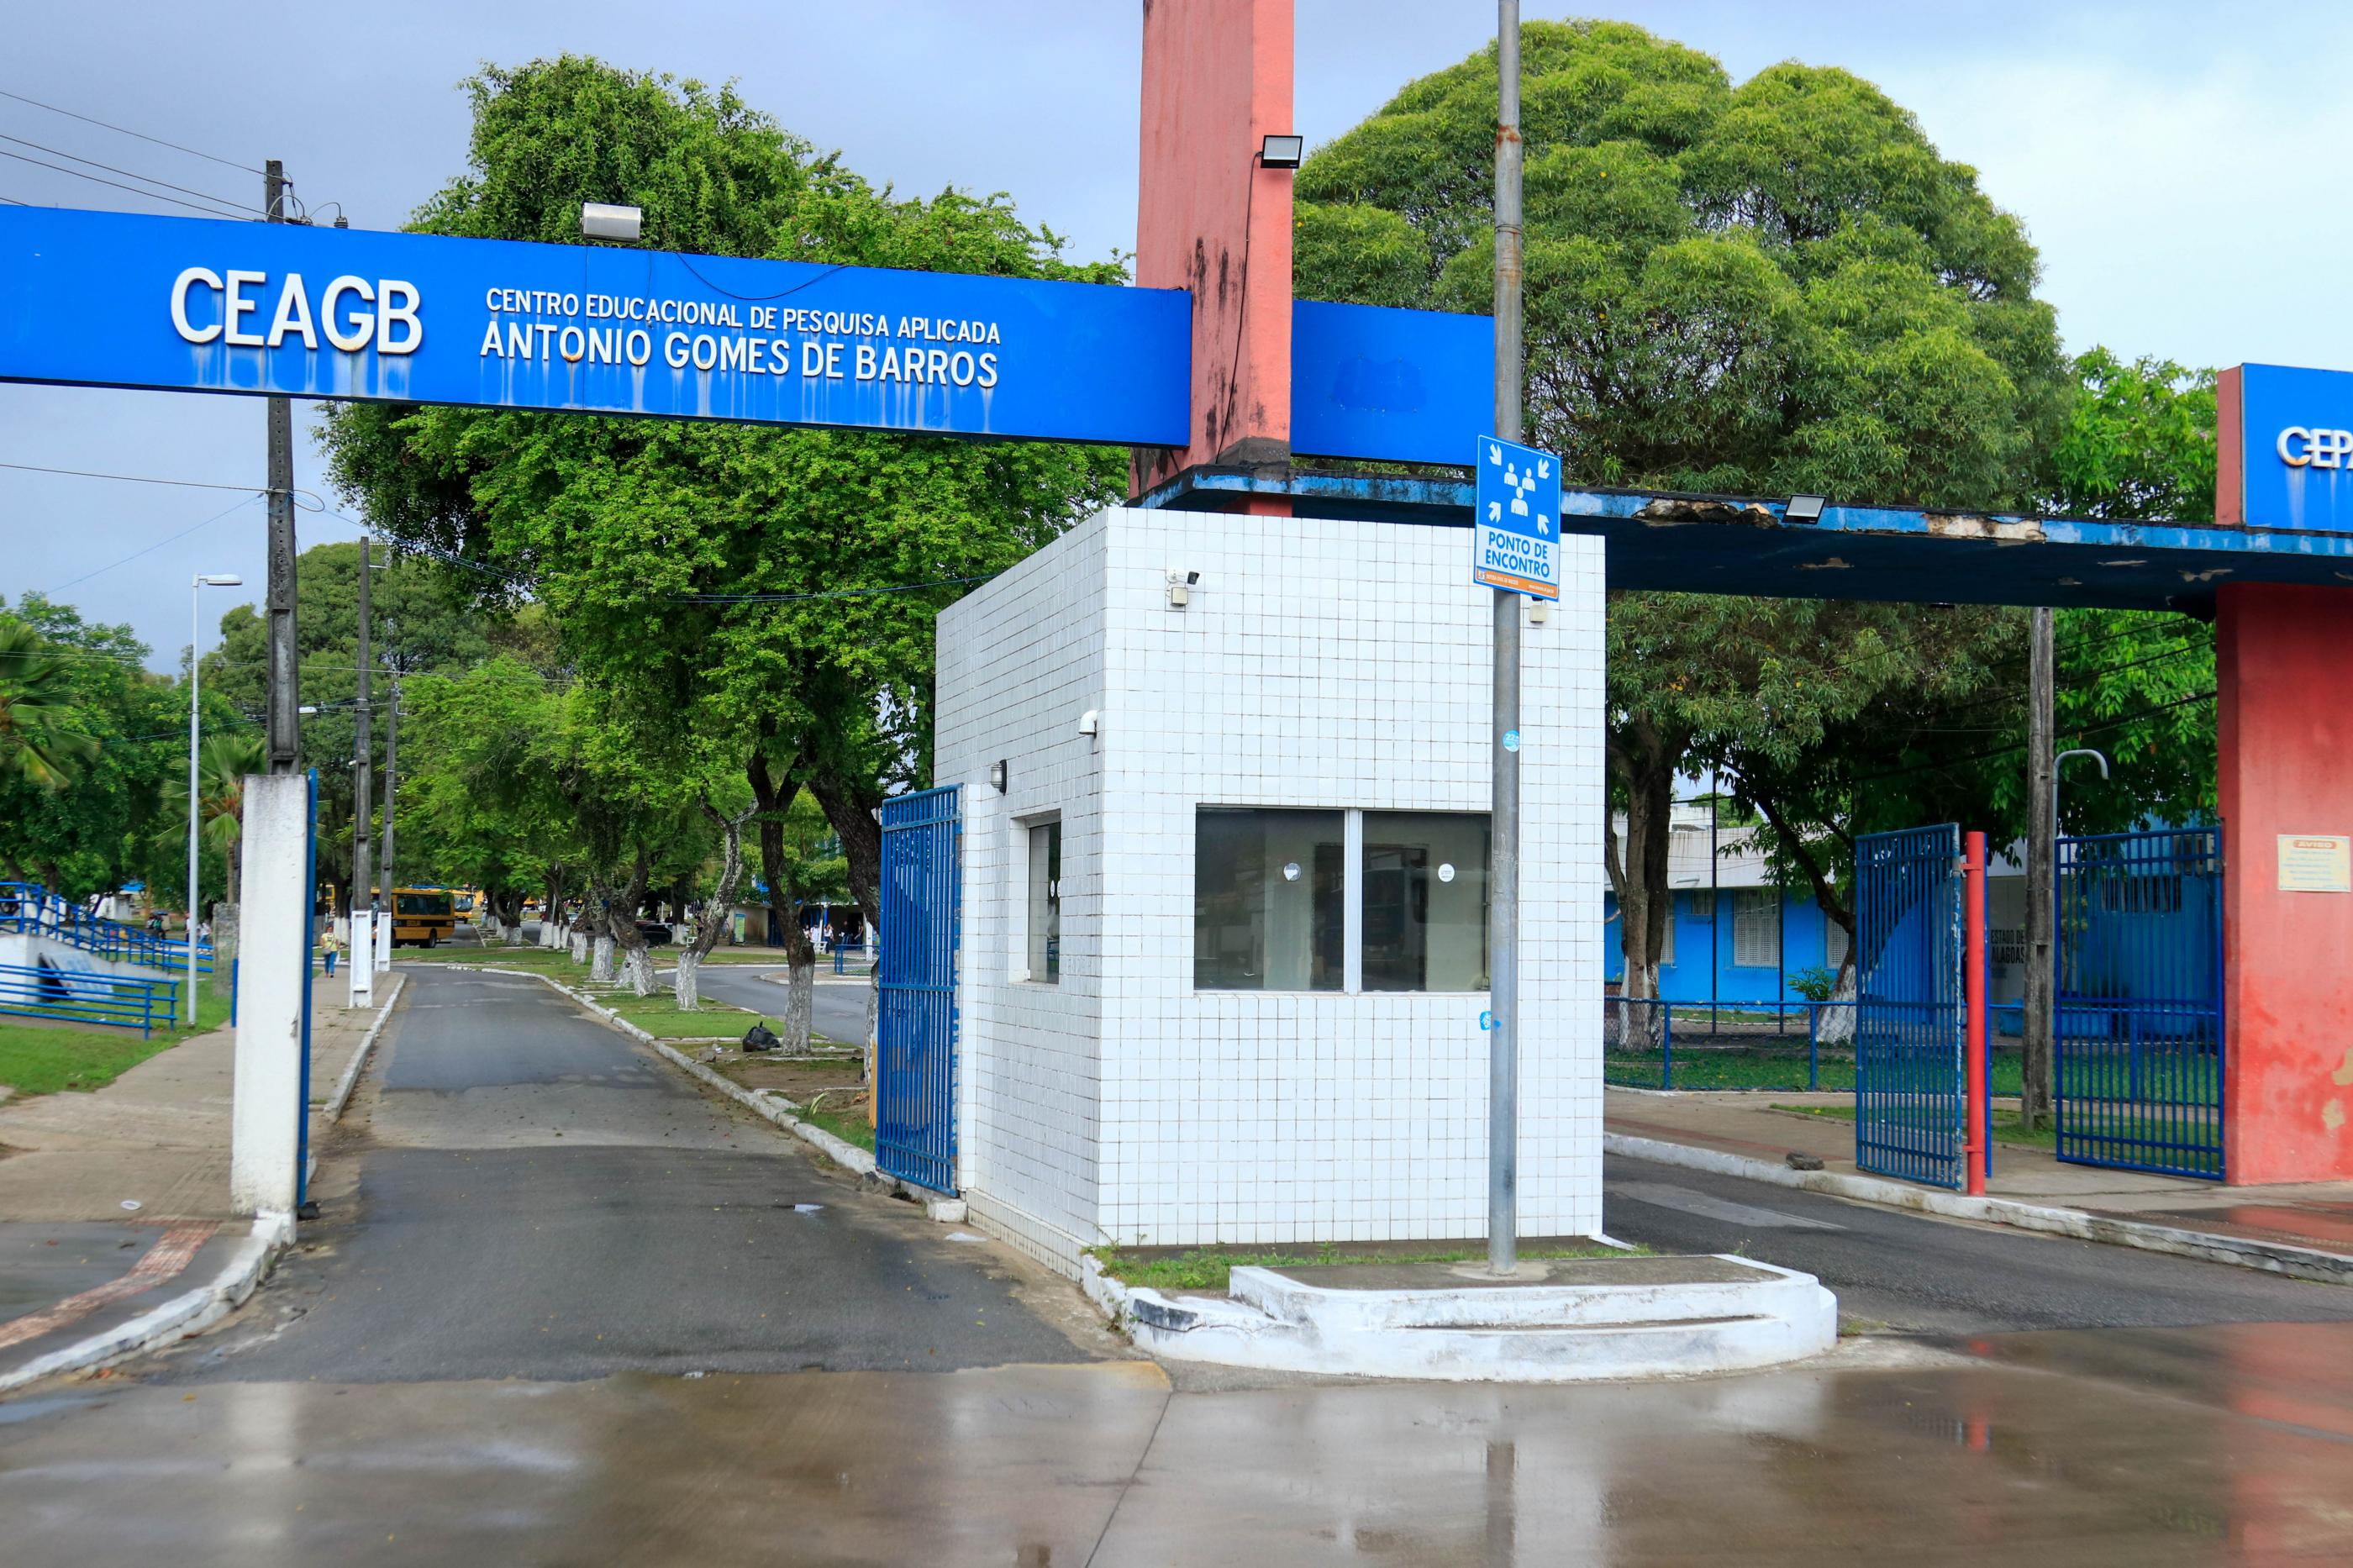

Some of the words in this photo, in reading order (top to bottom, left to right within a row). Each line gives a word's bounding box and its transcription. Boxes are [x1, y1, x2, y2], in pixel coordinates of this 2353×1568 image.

[171, 266, 423, 354] CEAGB
[486, 287, 579, 317] CENTRO
[586, 293, 743, 329] EDUCACIONAL
[750, 306, 777, 330] DE
[783, 308, 889, 336] PESQUISA
[897, 316, 1000, 345] APLICADA
[480, 320, 651, 366] ANTONIO
[664, 331, 790, 376] GOMES
[802, 341, 845, 378] DE
[855, 345, 998, 387] BARROS
[2276, 425, 2353, 470] CEP
[1485, 549, 1550, 578] ENCONTRO
[1488, 531, 1530, 555] PONTO
[1534, 543, 1548, 560] DE
[1991, 929, 2014, 944] ESTADO
[2016, 929, 2024, 944] DE
[1991, 946, 2024, 964] ALAGOAS
